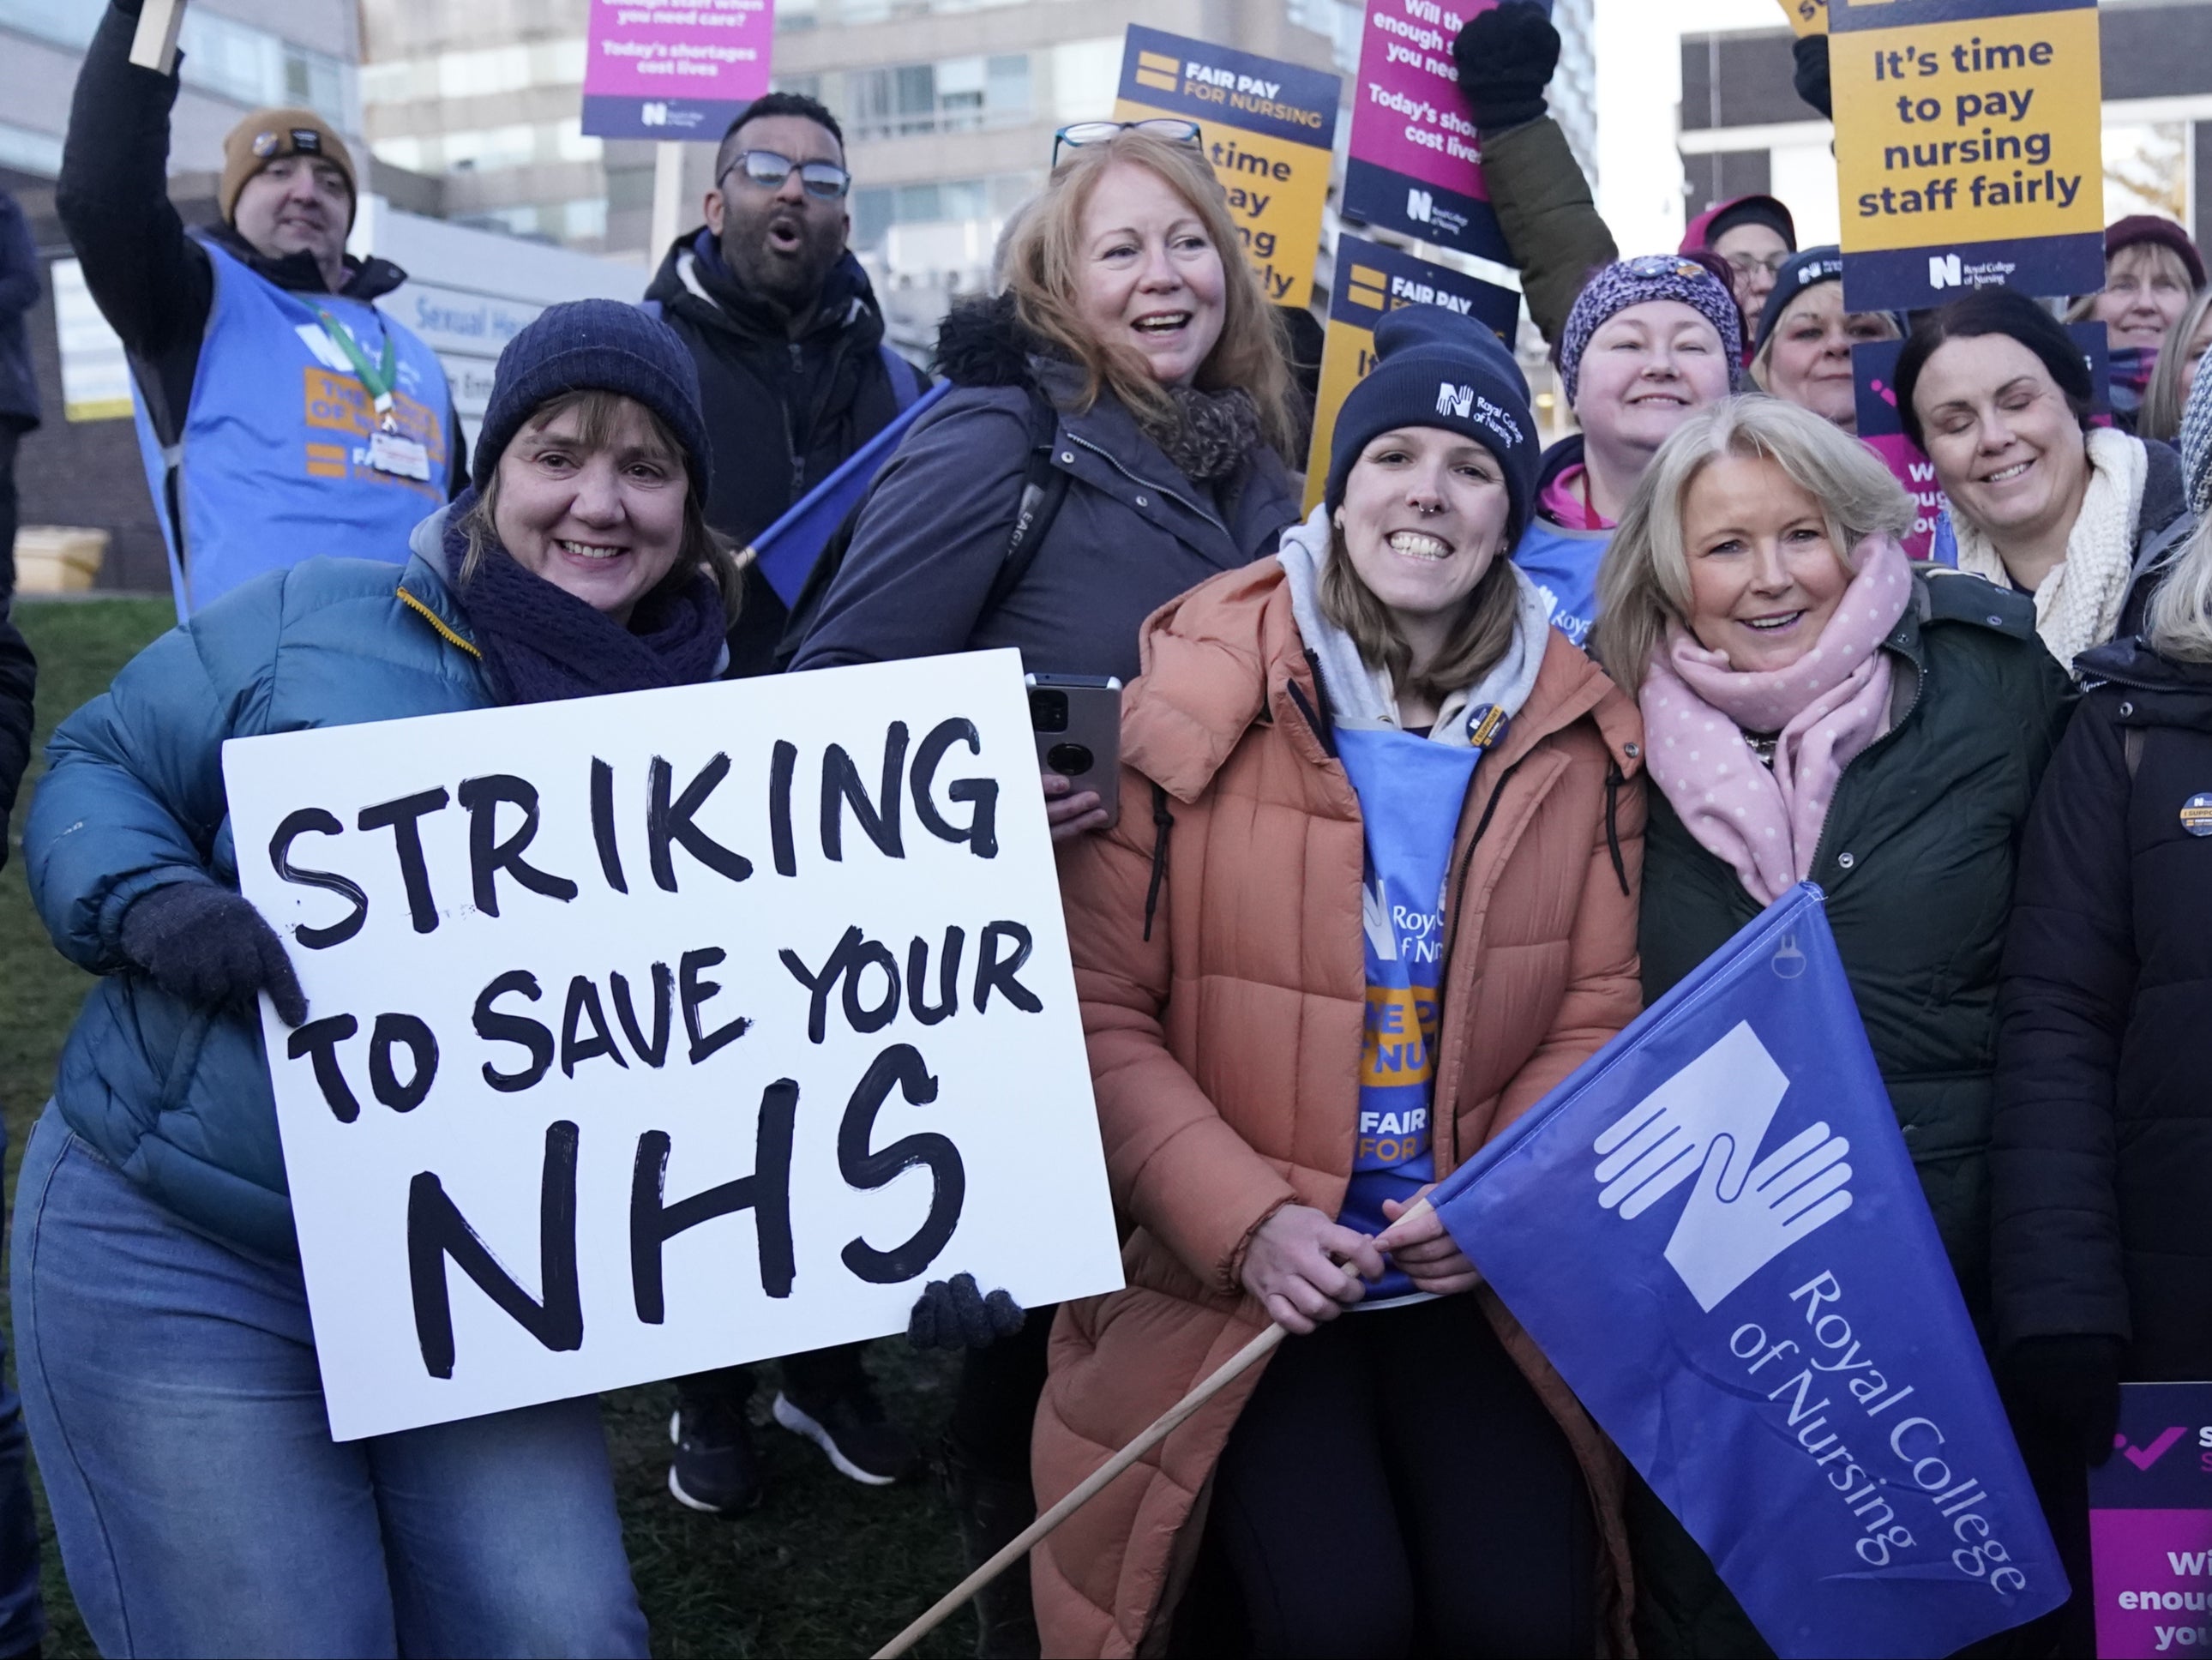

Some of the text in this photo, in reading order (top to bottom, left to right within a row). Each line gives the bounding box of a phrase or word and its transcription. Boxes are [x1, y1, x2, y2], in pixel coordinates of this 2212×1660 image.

[1373, 12, 1444, 51] enough
[1404, 0, 1464, 33] Will th
[1386, 42, 1460, 82] you nee
[1874, 37, 2054, 81] It's time
[1185, 62, 1282, 99] FAIR PAY
[1183, 81, 1323, 129] FOR NURSING
[1368, 82, 1479, 138] Today's shor
[1896, 87, 2035, 127] to pay
[1404, 125, 1444, 152] cost
[1884, 127, 2052, 171] nursing
[1211, 141, 1292, 183] time
[1222, 185, 1271, 219] ay
[1857, 169, 2083, 217] staff fairly
[1391, 275, 1435, 304] FAIR
[1435, 291, 1473, 316] PAY
[1473, 412, 1487, 424] of
[1476, 395, 1504, 418] Royal
[1908, 462, 1935, 483] W
[268, 717, 1000, 950] STRIKING
[1393, 905, 1437, 940] Roy
[287, 920, 1044, 1125] TO SAVE YOUR
[1359, 1107, 1427, 1135] FAIR
[1359, 1137, 1417, 1163] FOR
[407, 1043, 966, 1380] NHS
[1729, 1322, 1918, 1567] of Nursing
[1788, 1269, 2027, 1596] Royal College
